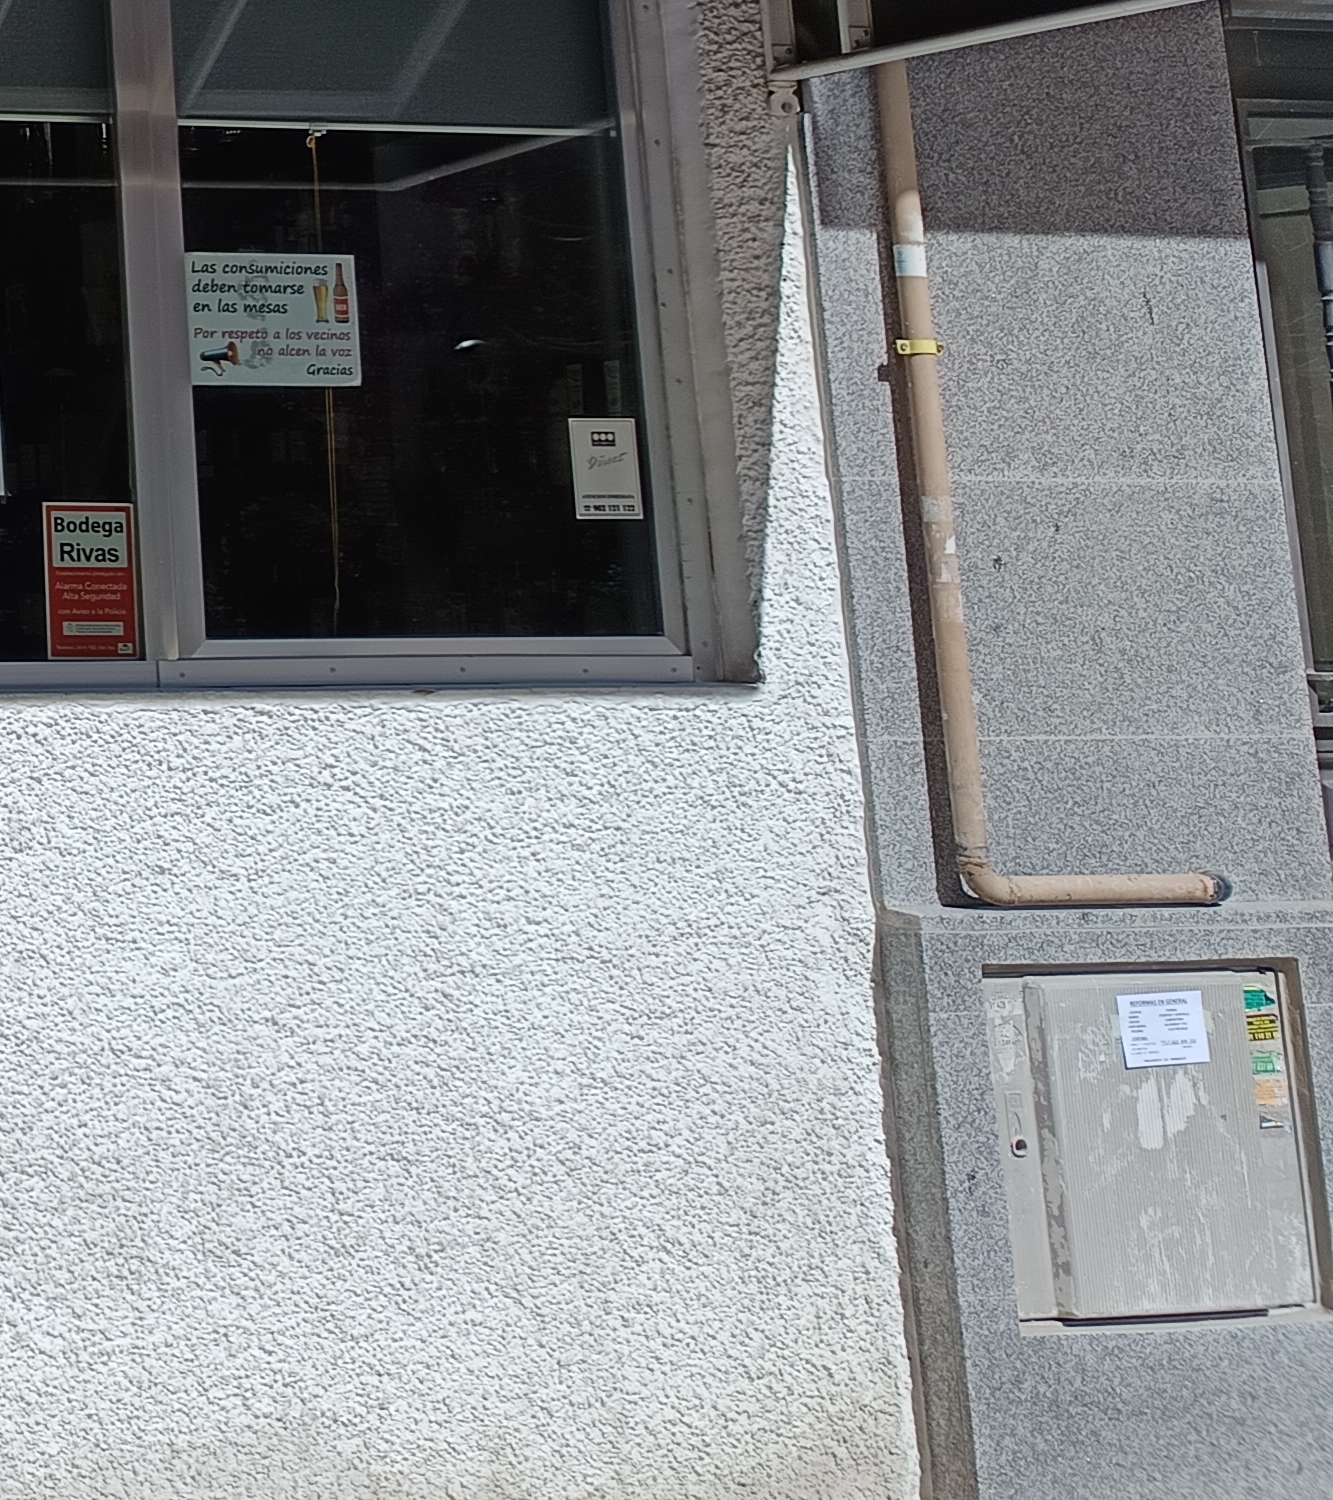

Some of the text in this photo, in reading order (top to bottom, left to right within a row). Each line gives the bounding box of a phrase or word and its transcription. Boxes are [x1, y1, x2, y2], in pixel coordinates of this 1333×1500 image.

[191, 260, 328, 276] Las consumiciones
[191, 278, 305, 295] deben tomarse
[193, 298, 288, 314] en las mesas
[193, 327, 351, 343] Por respeto a los vecinos
[257, 344, 353, 358] no alcen la voz
[306, 363, 354, 376] Gracias
[53, 516, 124, 538] Bodega
[59, 542, 120, 563] Rivas
[55, 582, 128, 591] Alarma Conectada
[62, 591, 121, 602] Alta Seguridad
